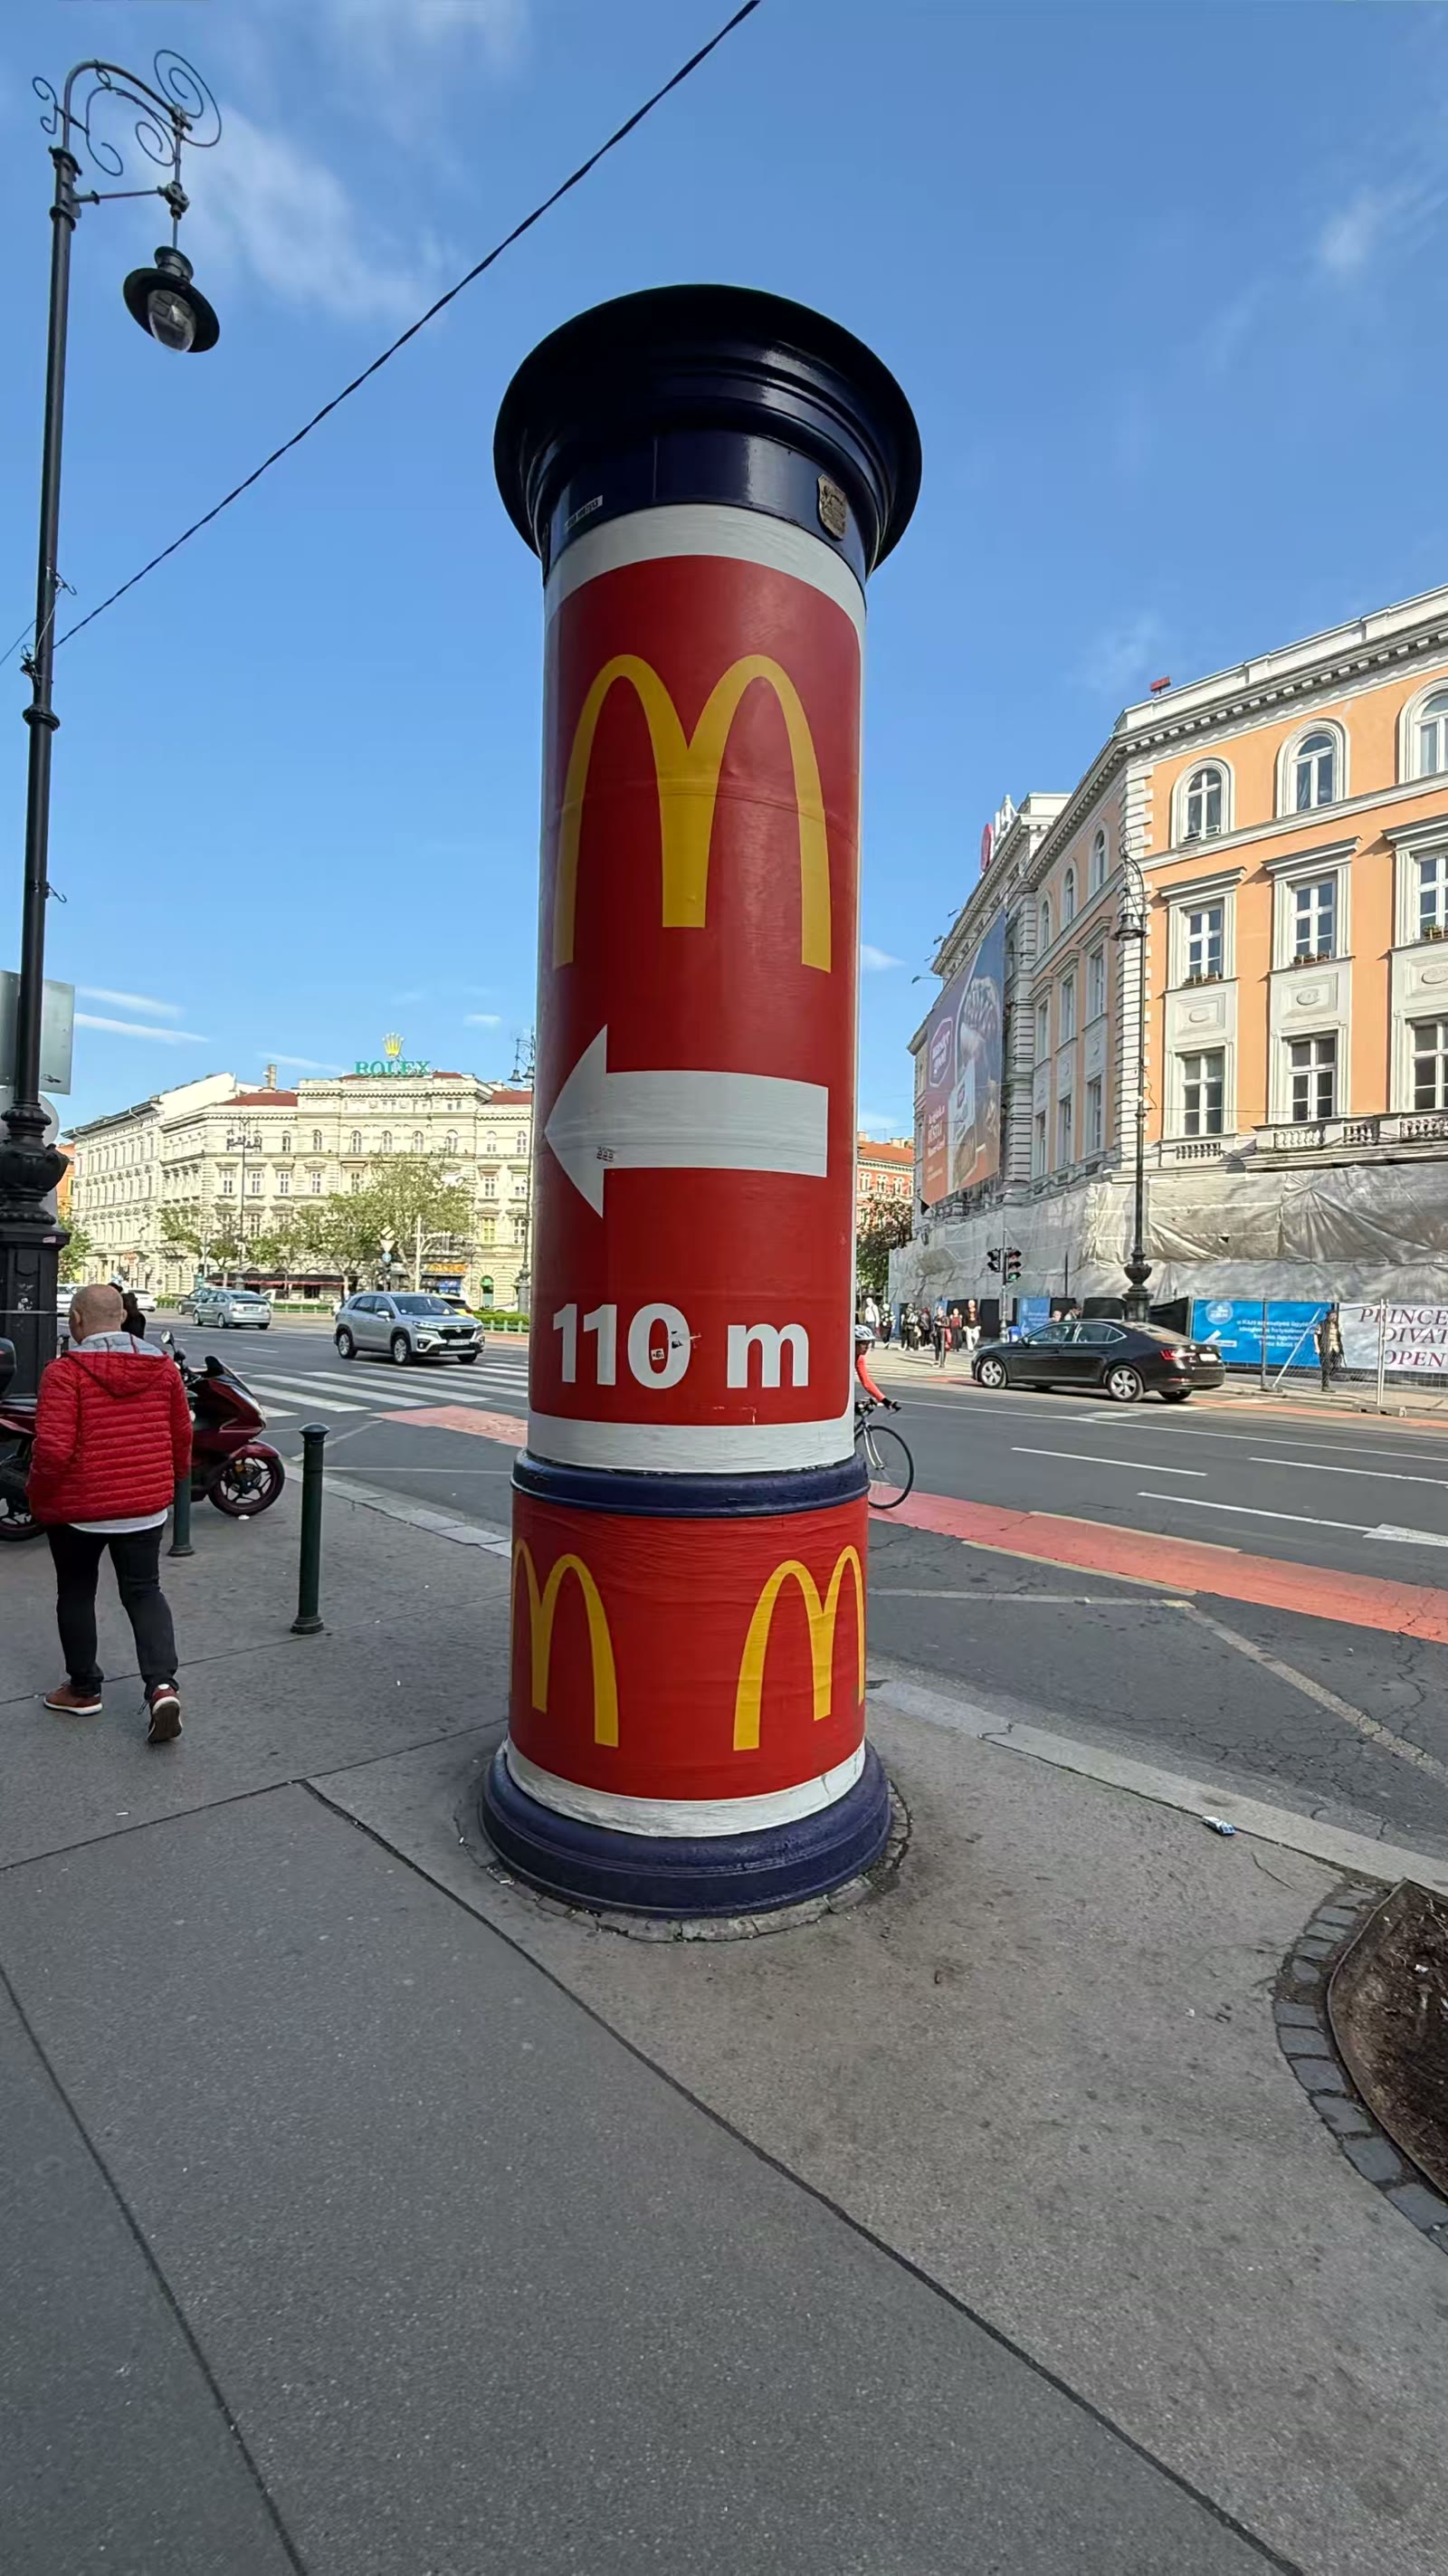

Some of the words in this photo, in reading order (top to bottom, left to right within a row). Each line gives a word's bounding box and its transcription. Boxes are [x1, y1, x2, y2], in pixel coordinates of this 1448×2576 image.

[355, 1061, 431, 1075] ROLEX
[553, 1303, 691, 1389] 110
[727, 1323, 809, 1388] m
[1384, 1350, 1445, 1367] OPEN
